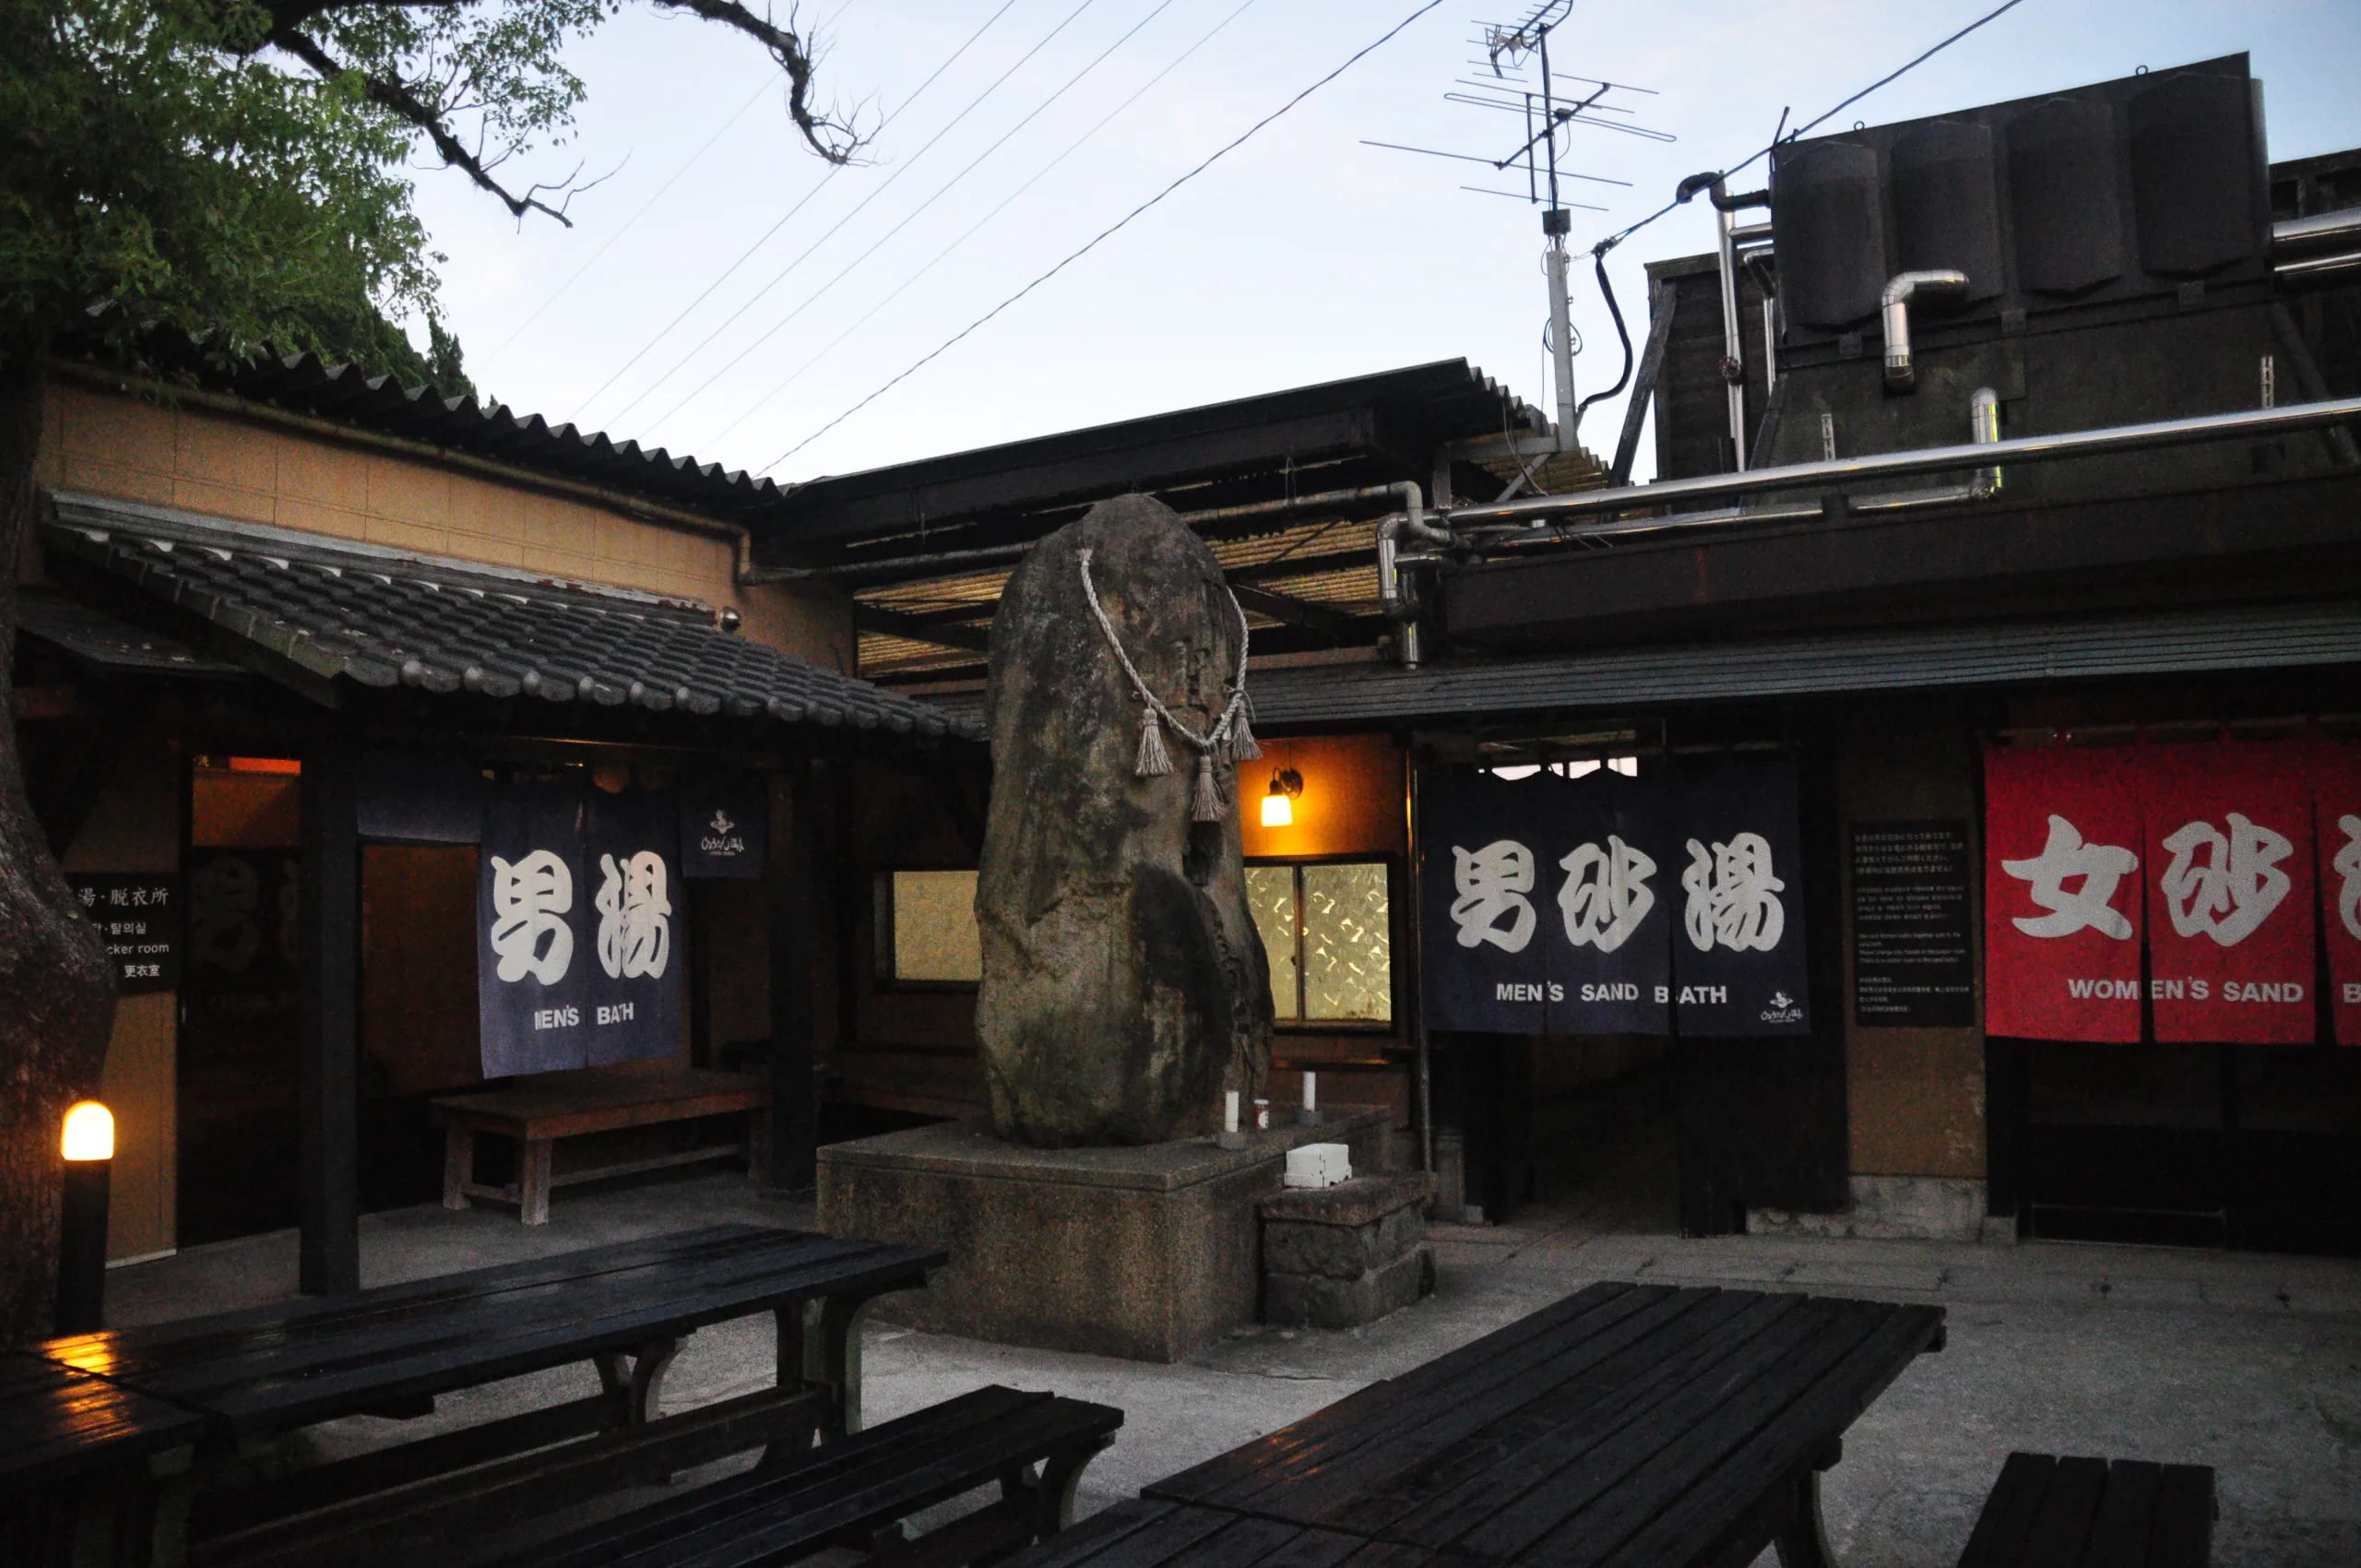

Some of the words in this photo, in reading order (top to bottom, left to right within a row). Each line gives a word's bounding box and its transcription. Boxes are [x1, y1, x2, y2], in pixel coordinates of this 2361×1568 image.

[1451, 833, 1786, 954] 男砂湯
[2000, 813, 2361, 948] 女砂
[490, 849, 672, 986] 男湯
[137, 943, 170, 955] room
[124, 964, 160, 979] 更衣室
[1496, 980, 1565, 1003] MEN'S
[1580, 982, 1639, 1003] SAND
[1654, 984, 1727, 1004] BATH
[2067, 975, 2210, 1002] WOMEN'S
[2223, 981, 2304, 1003] SAND
[533, 1004, 580, 1031] MEN'S
[596, 1002, 635, 1026] BATH
